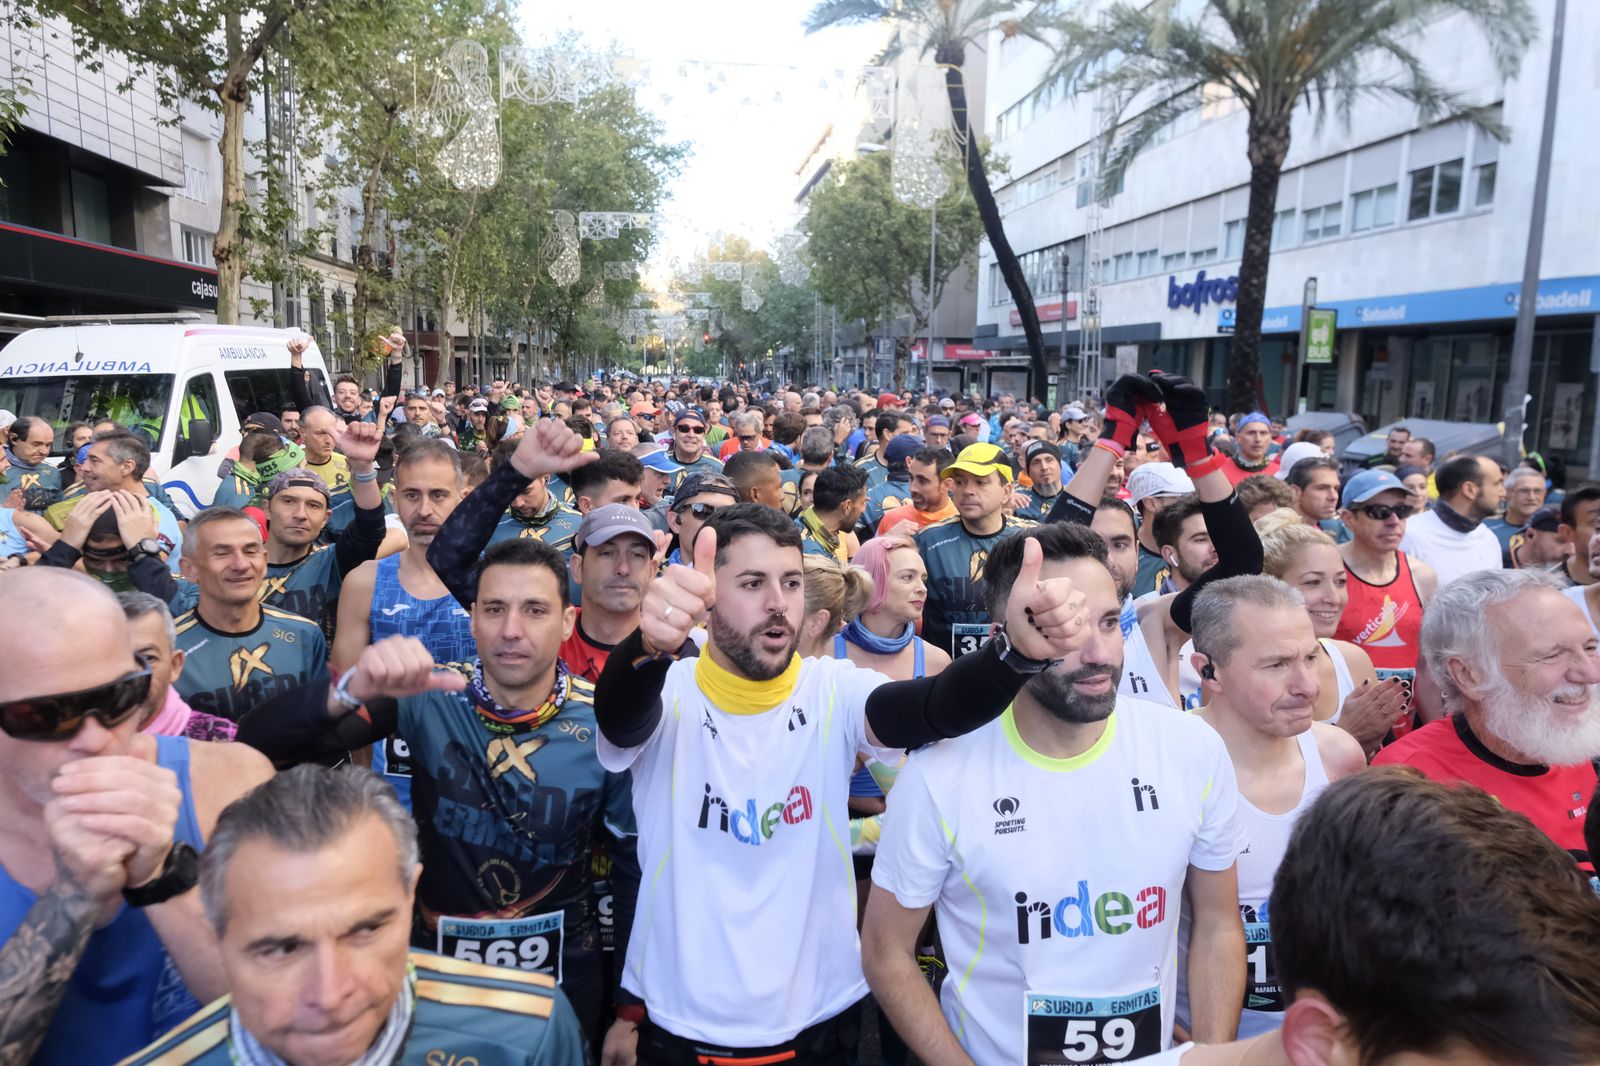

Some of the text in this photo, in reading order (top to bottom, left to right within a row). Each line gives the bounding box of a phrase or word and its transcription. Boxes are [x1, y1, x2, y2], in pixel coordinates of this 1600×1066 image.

[218, 346, 268, 359] AMBULANCIA
[272, 628, 296, 643] SIG
[558, 719, 592, 744] SIG
[1131, 777, 1160, 812] in
[697, 782, 813, 846] indea
[994, 818, 1027, 829] SPORTING
[1014, 879, 1168, 945] indea
[455, 924, 496, 937] SUBIDA
[509, 917, 559, 937] ERMITAS
[453, 936, 550, 970] 569
[1044, 999, 1095, 1015] SUBIDA
[1111, 990, 1159, 1014] ERMITAS
[1254, 986, 1277, 994] RAFAEL
[1062, 1018, 1136, 1062] 59
